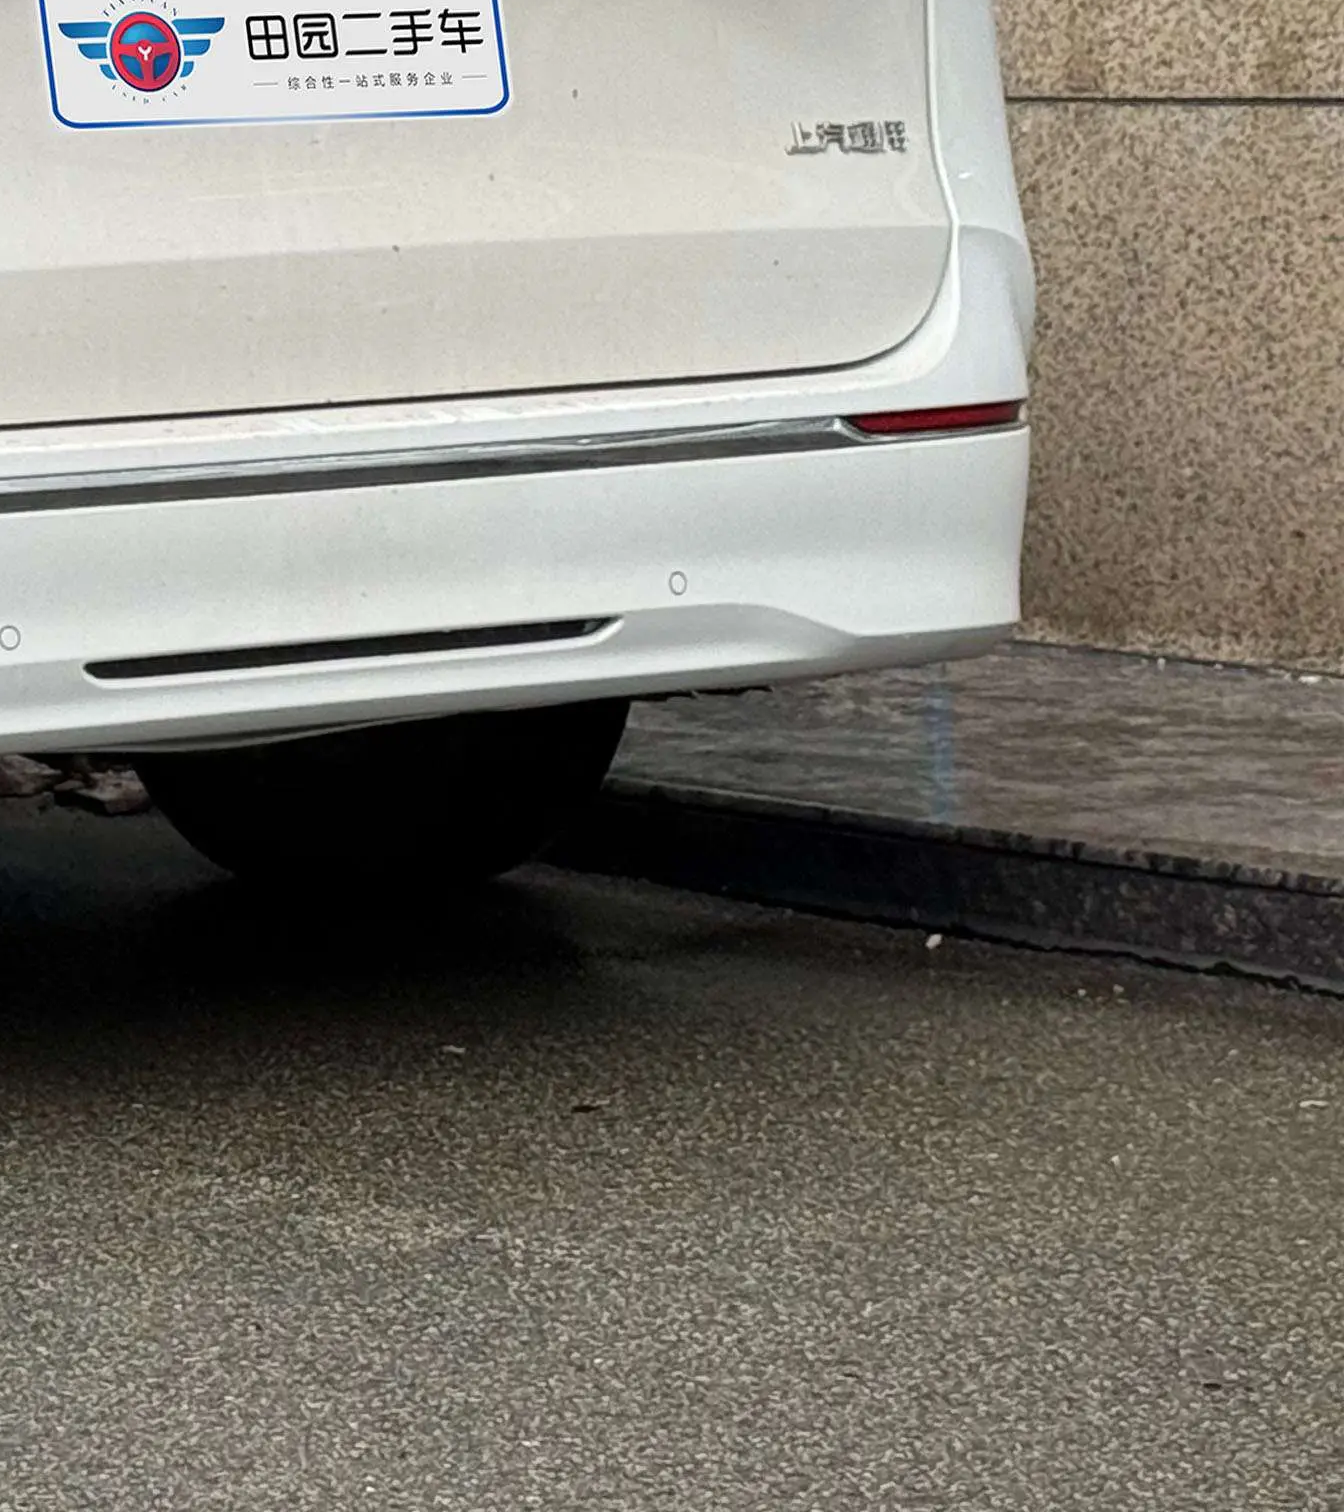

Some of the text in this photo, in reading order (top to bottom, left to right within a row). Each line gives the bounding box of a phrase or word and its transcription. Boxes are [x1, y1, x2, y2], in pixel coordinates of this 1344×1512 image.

[245, 8, 484, 61] 田园二手车
[287, 71, 454, 91] 综合性一站式服务企业
